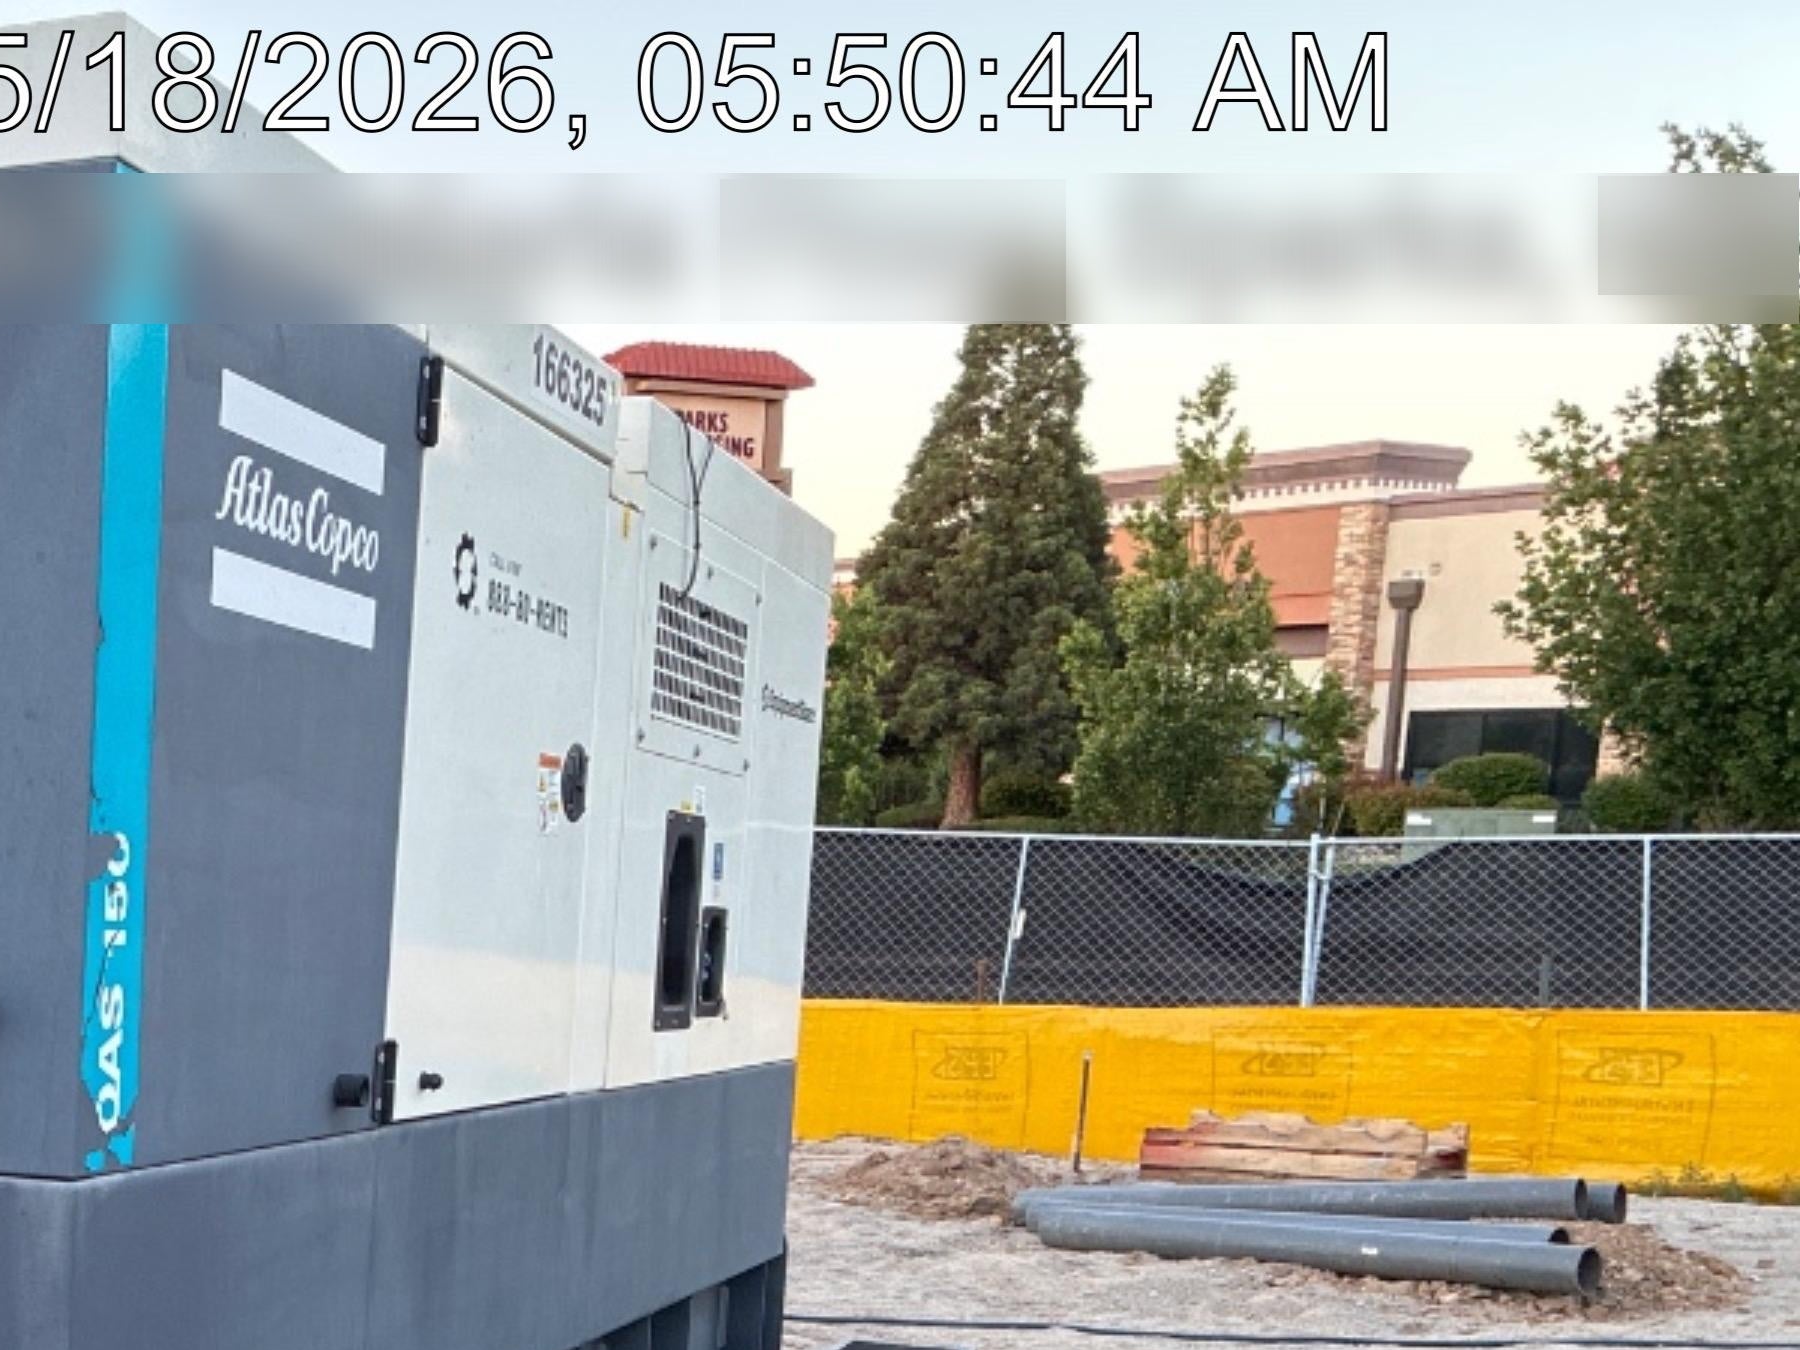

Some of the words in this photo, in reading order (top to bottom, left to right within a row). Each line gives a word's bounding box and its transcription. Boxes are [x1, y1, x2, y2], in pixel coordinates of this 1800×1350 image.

[533, 332, 607, 427] 166325
[675, 410, 729, 433] ARKS
[215, 455, 303, 546] Atlas
[305, 487, 379, 576] Copco
